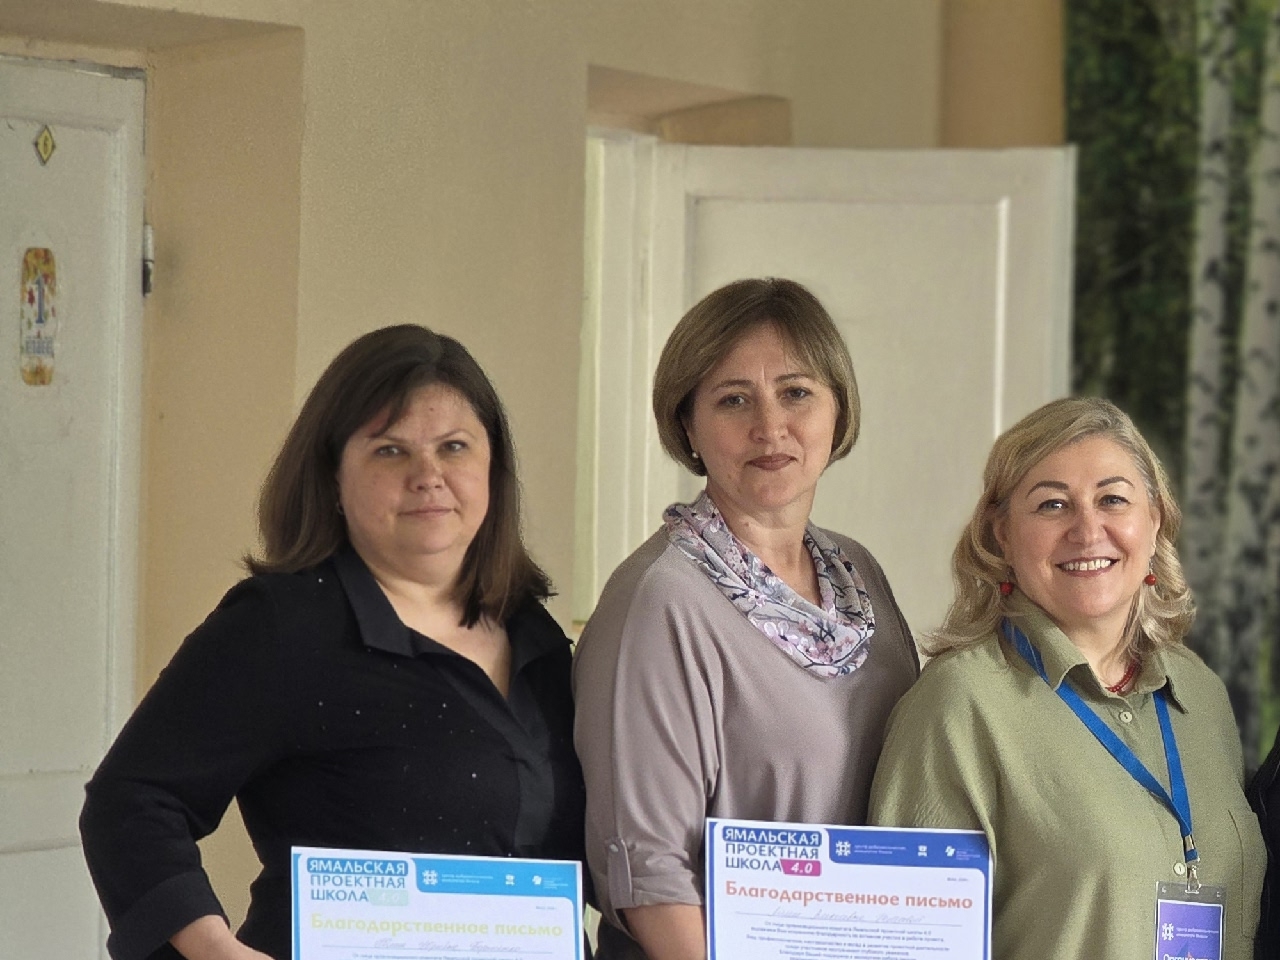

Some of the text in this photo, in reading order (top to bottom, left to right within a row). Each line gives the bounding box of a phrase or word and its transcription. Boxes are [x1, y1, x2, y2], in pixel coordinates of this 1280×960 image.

[725, 828, 819, 845] ЯМАЛЬСКАЯ
[725, 843, 819, 859] ПРОЕКТНАЯ
[309, 859, 405, 875] ЯМАЛЬСКАЯ
[725, 857, 813, 874] ШКОЛА 4.0
[310, 874, 405, 889] ПРОЕКТНАЯ
[311, 889, 369, 902] ШКОЛА
[726, 880, 973, 909] Благодарственное письмо
[311, 912, 563, 937] Благодарственное письмо
